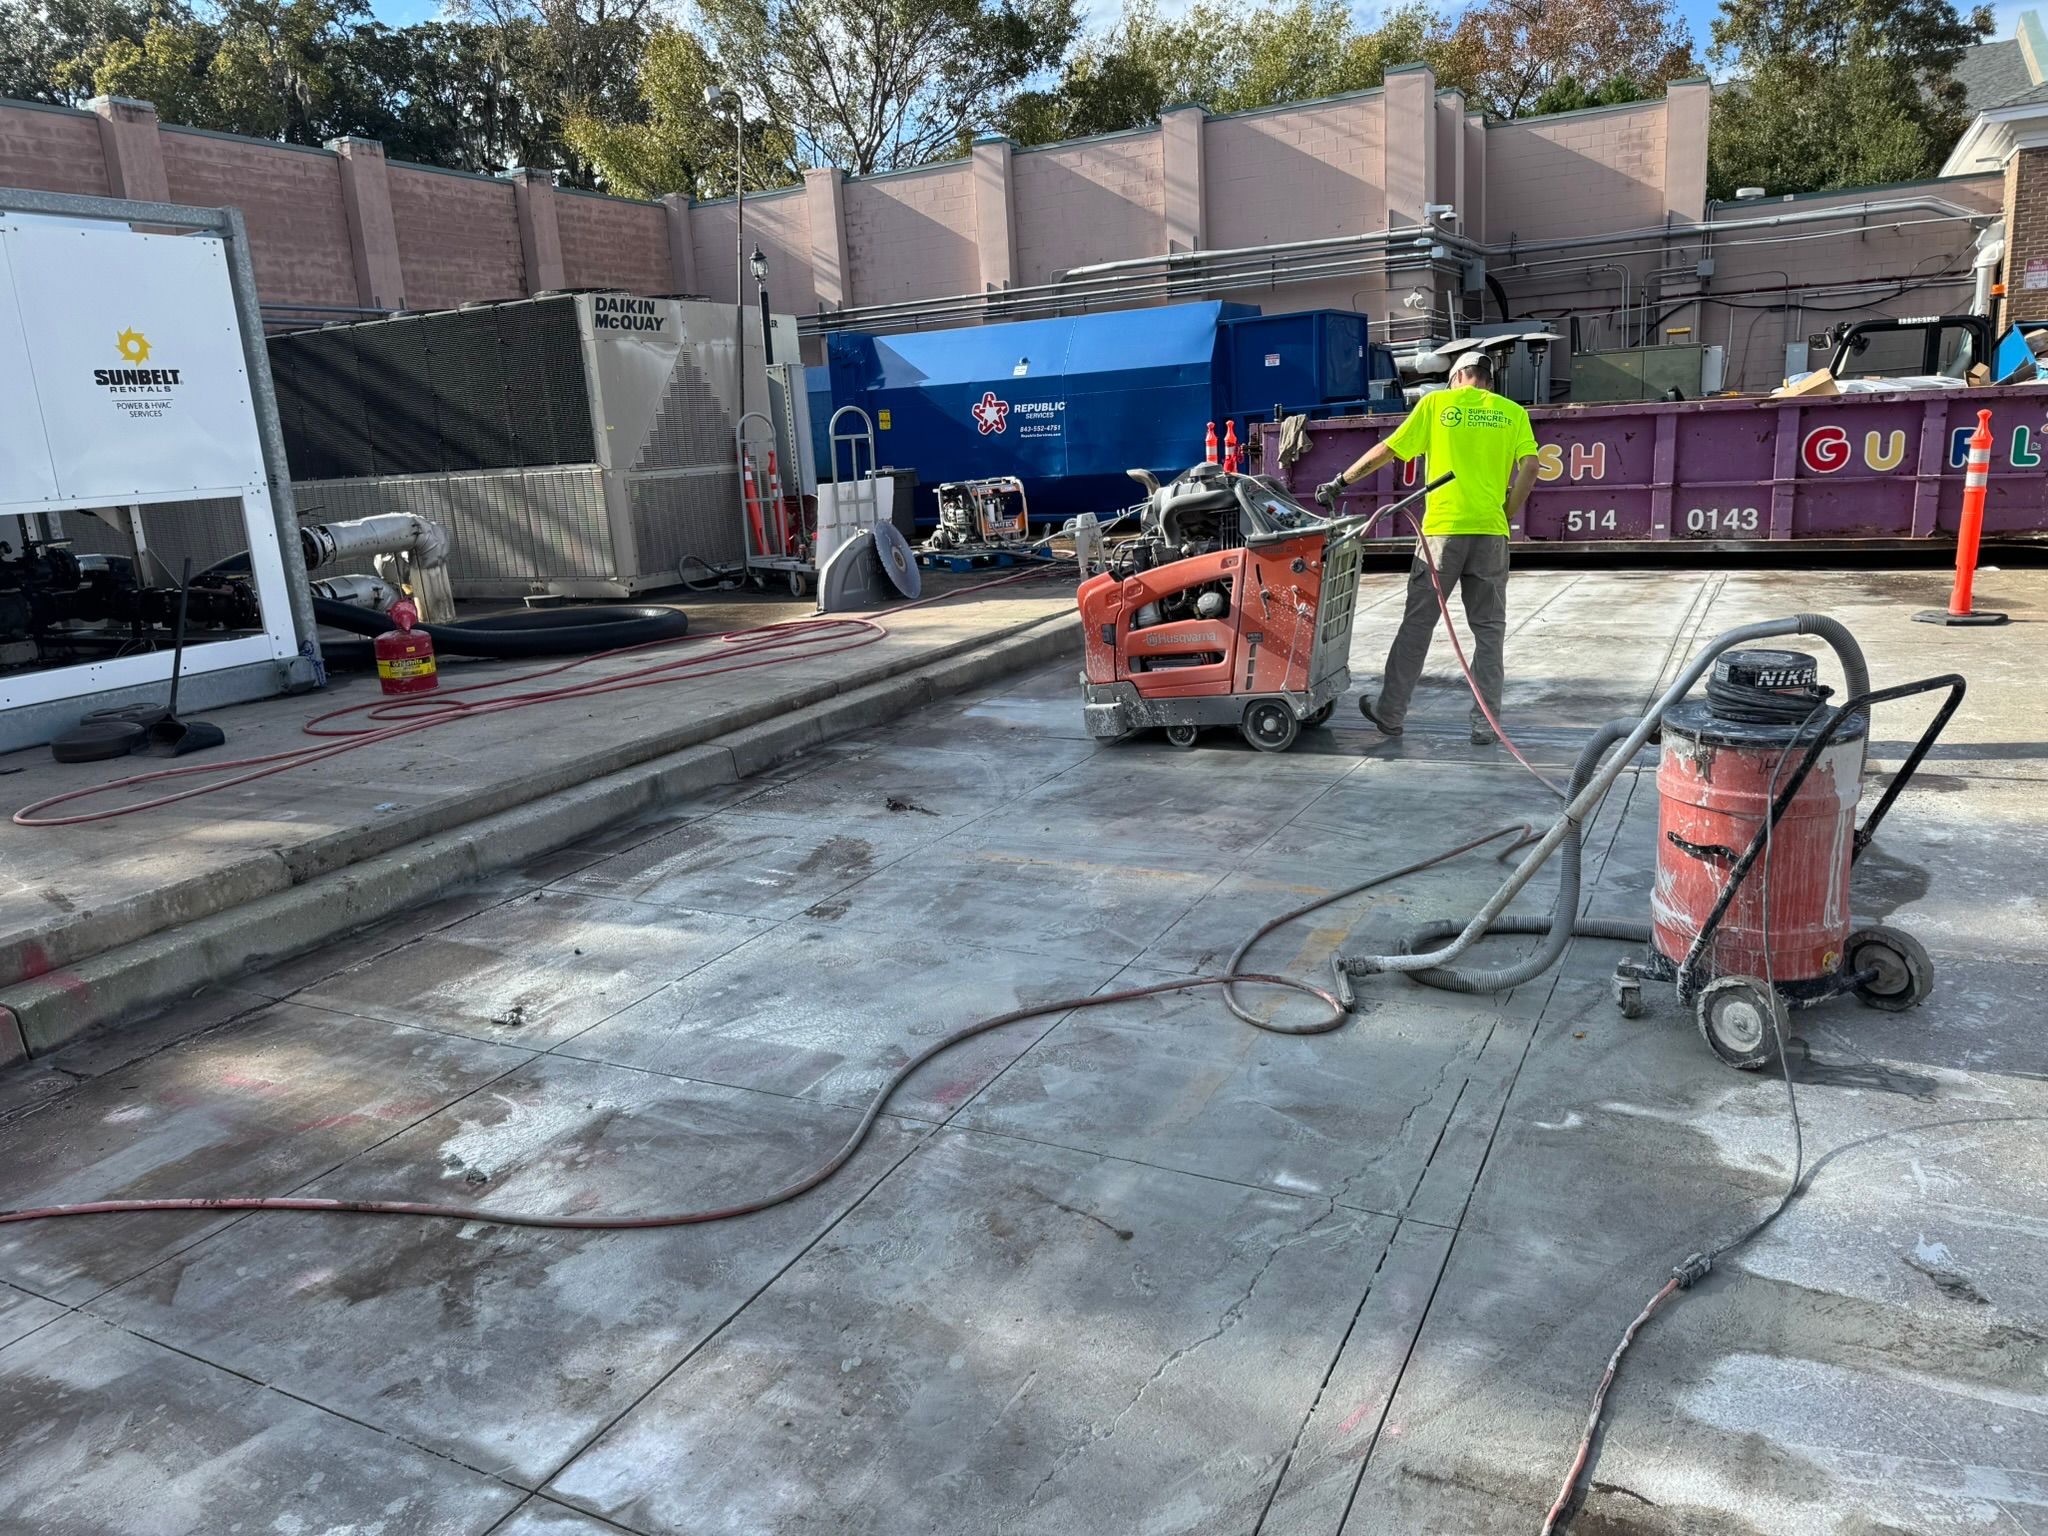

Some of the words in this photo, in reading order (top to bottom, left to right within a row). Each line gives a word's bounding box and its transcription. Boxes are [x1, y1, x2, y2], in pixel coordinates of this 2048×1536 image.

[595, 297, 656, 315] DAIKIN
[595, 314, 665, 332] McQUAY
[94, 369, 180, 386] SUNBELT
[116, 402, 143, 410] POWER
[151, 401, 172, 409] HVAC
[1014, 402, 1066, 413] REPUBLIC
[129, 410, 163, 418] SERVICES
[1025, 412, 1055, 420] SERVICES
[1468, 408, 1504, 416] SUPERIOR
[1467, 414, 1513, 426] CONCRETE
[1567, 509, 1617, 532] 514
[1687, 508, 1760, 532] 0143
[1158, 631, 1217, 644] Husqvarna
